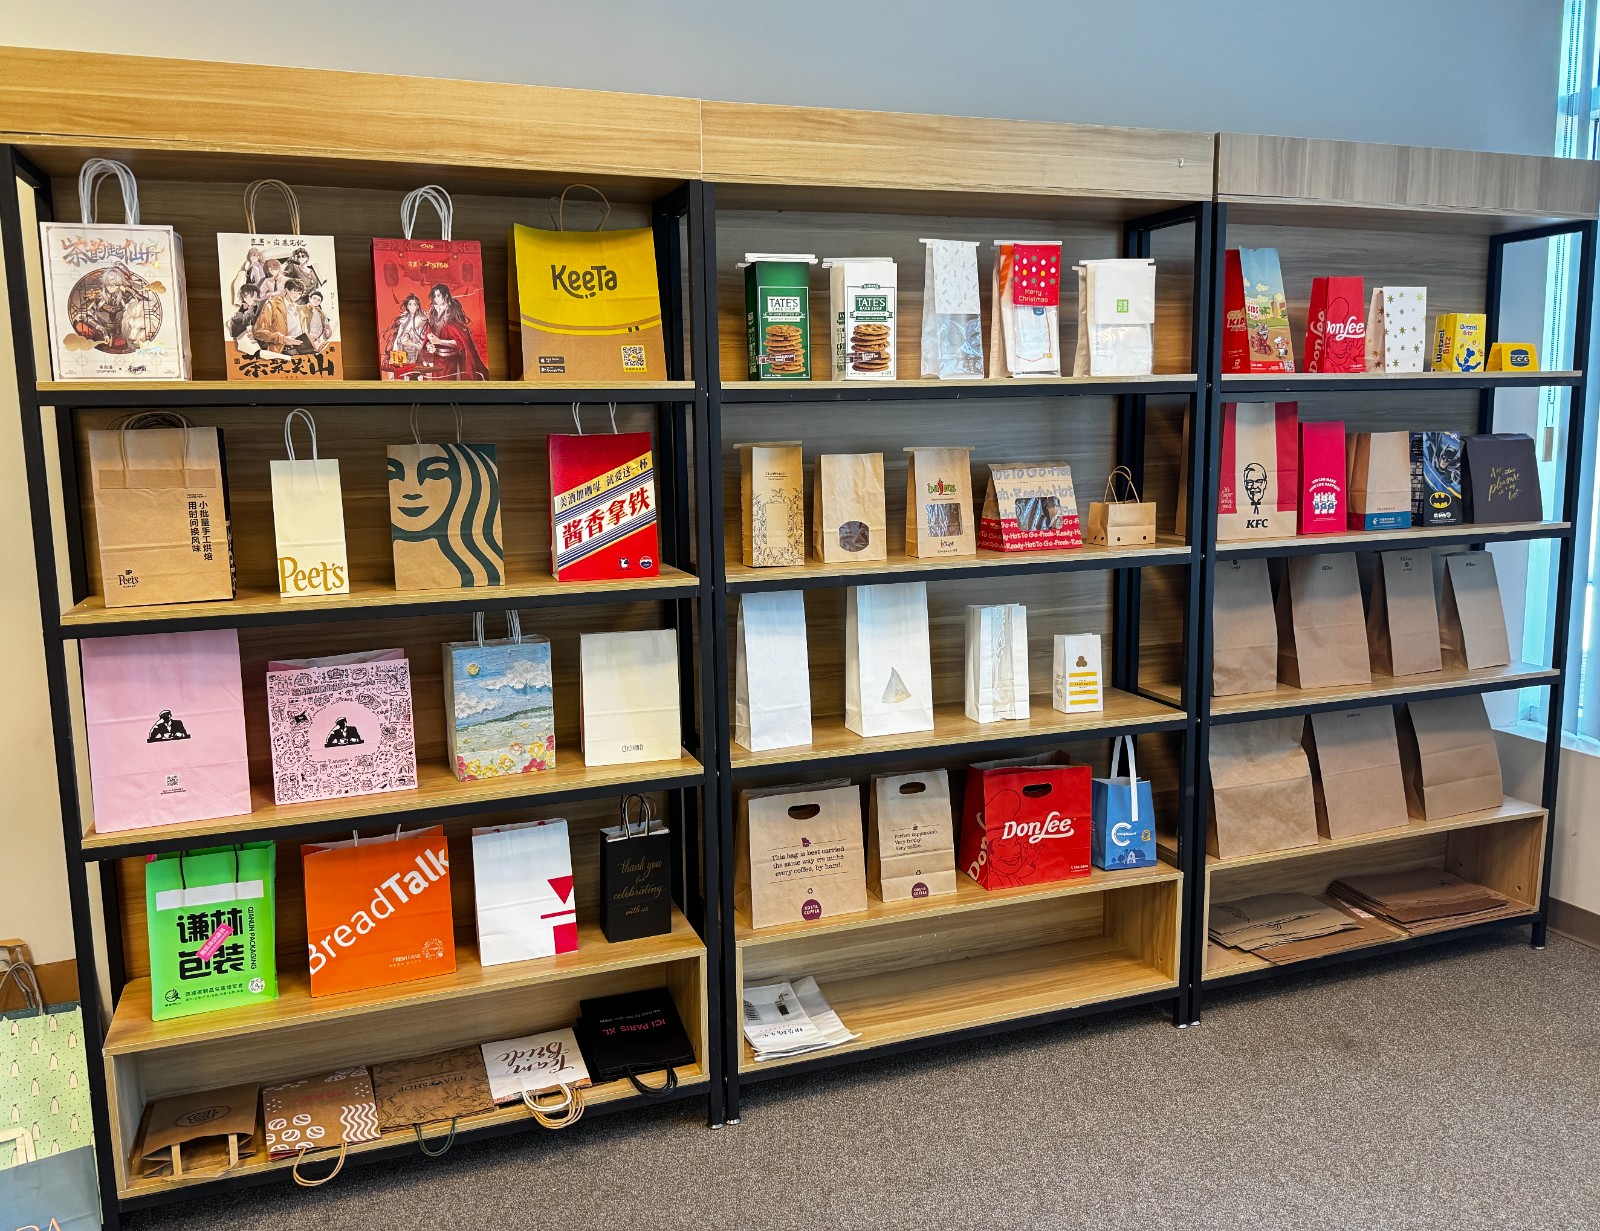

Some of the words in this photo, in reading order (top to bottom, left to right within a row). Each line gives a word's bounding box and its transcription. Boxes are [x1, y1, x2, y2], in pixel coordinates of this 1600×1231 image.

[551, 264, 618, 299] KeeTa
[1024, 288, 1042, 296] Merry
[769, 298, 798, 308] TATE'S
[856, 298, 886, 306] TATE'S
[560, 480, 600, 508] 美酒加咖啡
[606, 458, 648, 486] 就爱这一杯
[188, 501, 201, 552] 用时间换风味
[562, 486, 650, 550] 酱香拿铁
[1246, 518, 1268, 528] KFC
[199, 501, 212, 560] 小批量手工烘焙
[278, 556, 344, 594] Peet's
[1002, 810, 1074, 844] DonLee
[822, 846, 845, 854] carried
[618, 856, 646, 874] thank
[644, 860, 662, 878] you
[784, 860, 800, 868] same
[794, 866, 814, 874] coffee,
[614, 884, 667, 899] celebrating
[308, 848, 450, 976] BreadTalk
[179, 943, 244, 980] 包装
[602, 1028, 616, 1036] XL
[620, 1022, 649, 1032] PARIS
[651, 1018, 666, 1028] ICI
[495, 1042, 570, 1067] Bride
[506, 1055, 574, 1074] Team
